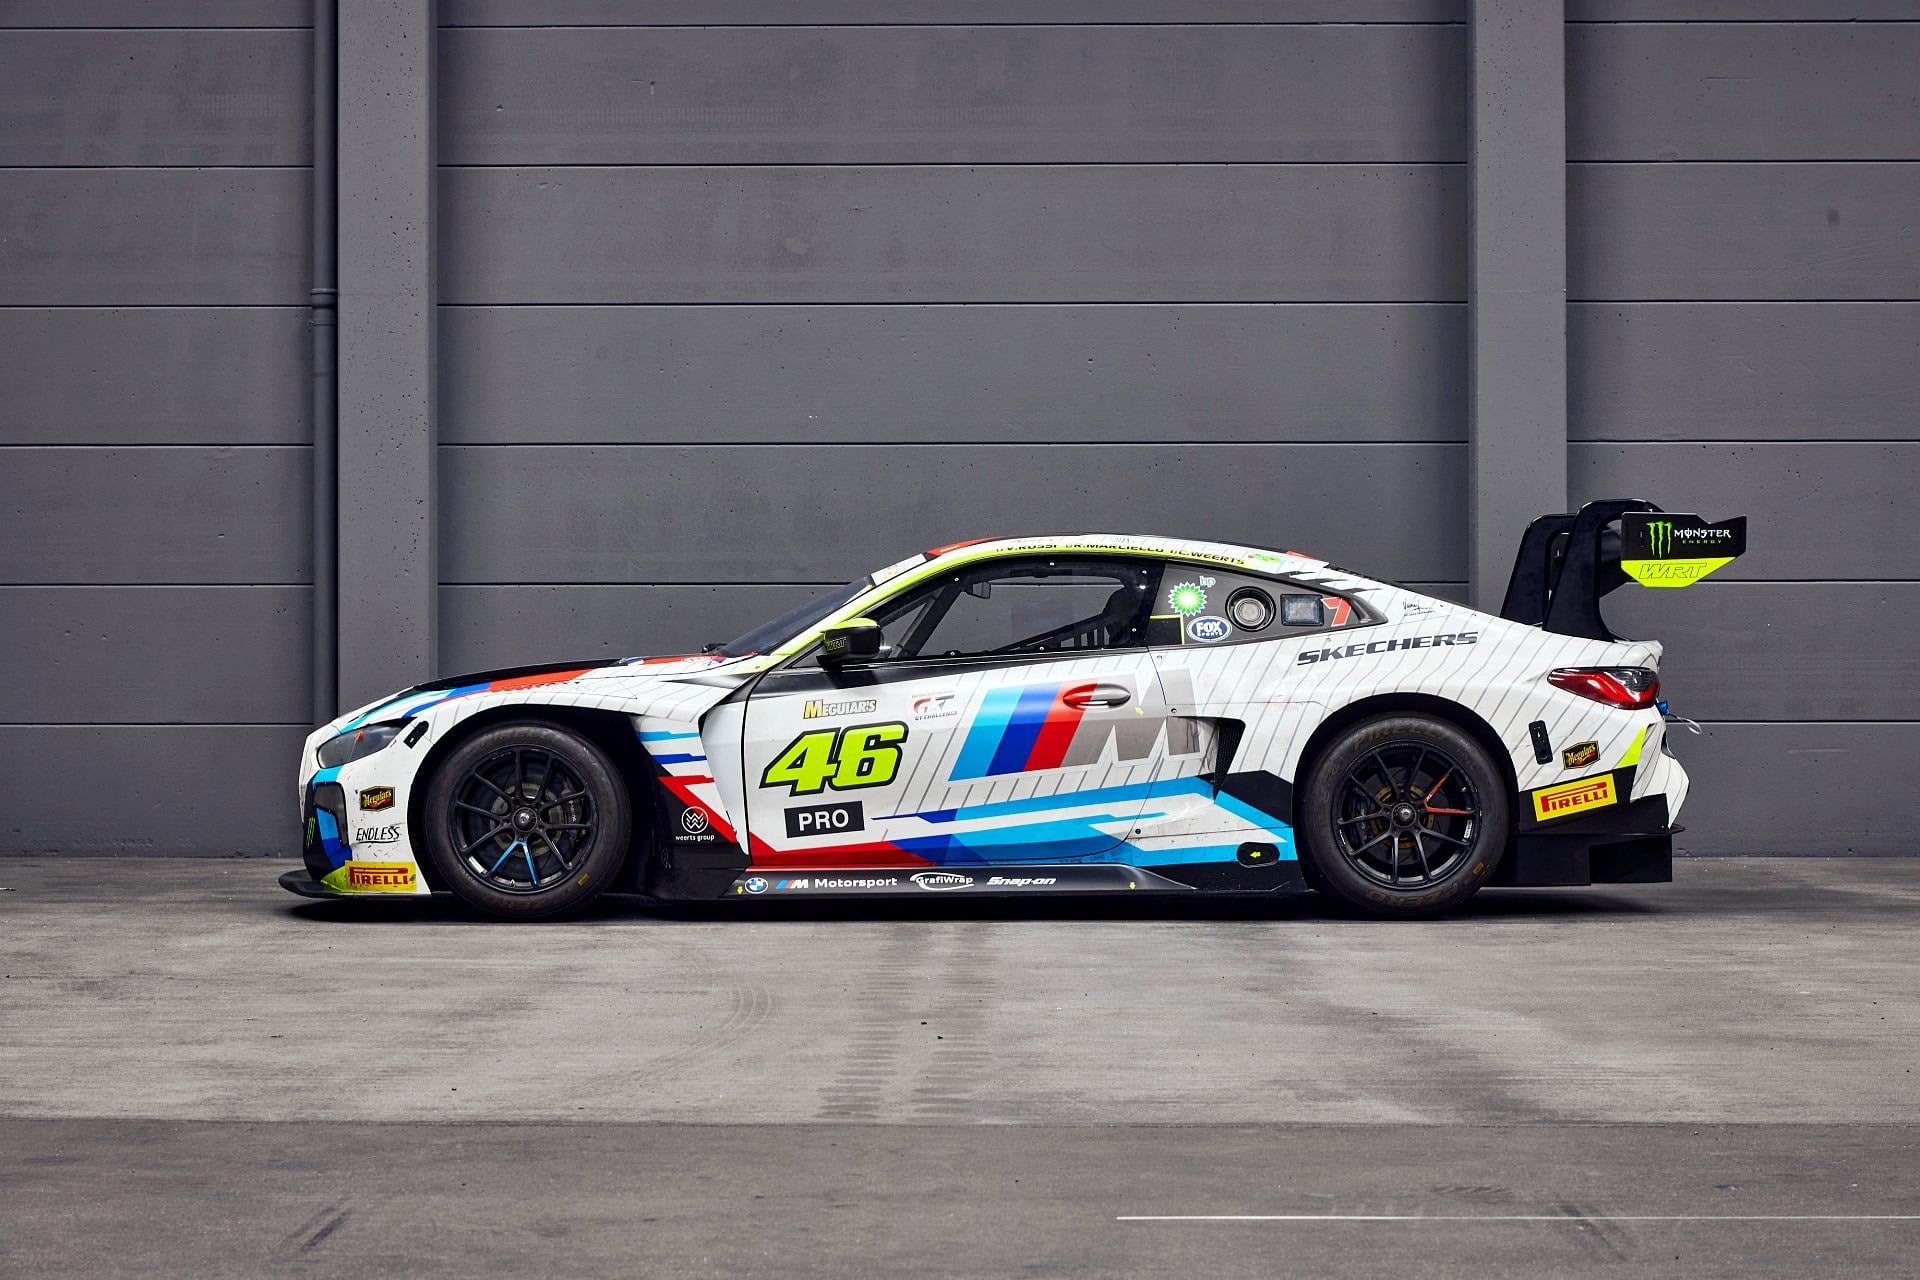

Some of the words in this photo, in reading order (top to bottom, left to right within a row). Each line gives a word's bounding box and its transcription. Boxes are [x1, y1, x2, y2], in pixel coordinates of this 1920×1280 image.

[1674, 528, 1731, 539] MONSTER
[1639, 563, 1707, 579] WRT
[1199, 575, 1216, 588] bp
[1196, 621, 1221, 634] FOX
[1297, 631, 1479, 666] SKECHERS
[803, 699, 876, 719] MEGUIAR'S
[924, 711, 958, 720] CHALLENGE
[759, 720, 909, 797] 46
[1540, 782, 1609, 814] PIRELLI
[798, 808, 849, 832] PRO
[356, 827, 400, 841] ENDLESS
[697, 834, 715, 842] group
[349, 866, 409, 886] PIRELLI
[815, 877, 898, 889] Motorsport
[986, 876, 1057, 887] Snap-on
